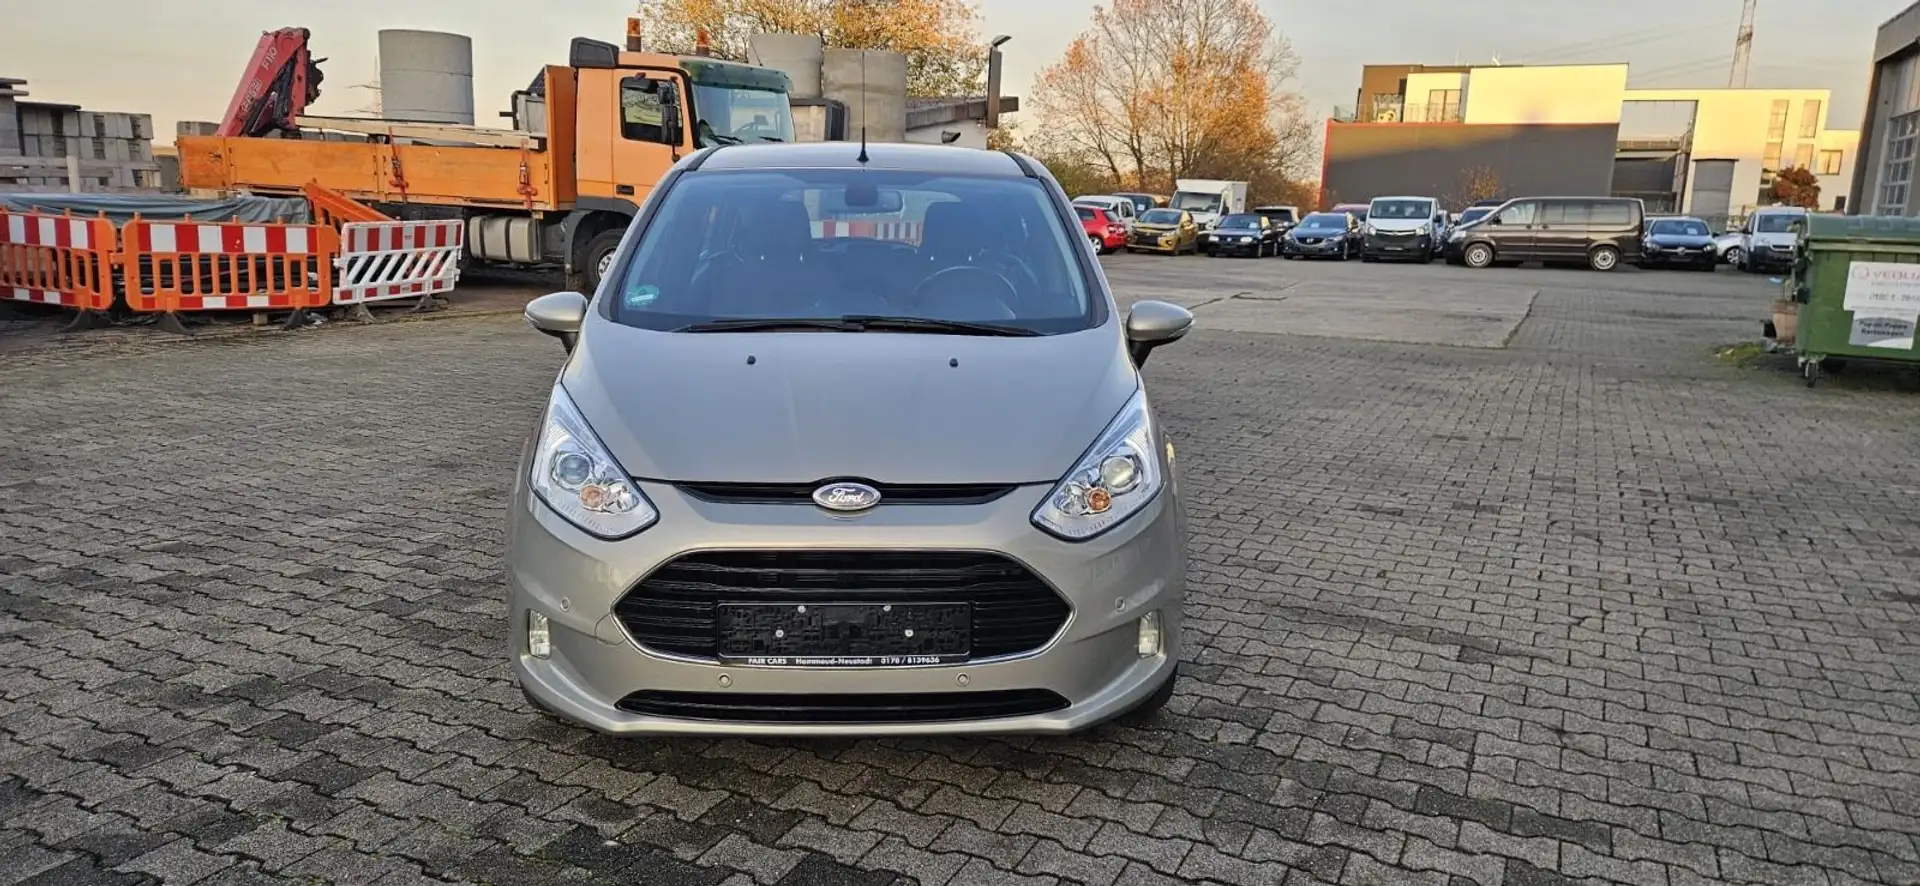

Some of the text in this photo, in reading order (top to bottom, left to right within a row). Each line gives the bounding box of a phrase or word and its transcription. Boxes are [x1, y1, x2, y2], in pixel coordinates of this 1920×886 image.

[261, 46, 278, 70] F110
[828, 487, 865, 504] Ford
[747, 657, 765, 665] FAIR
[767, 657, 788, 665] CARS
